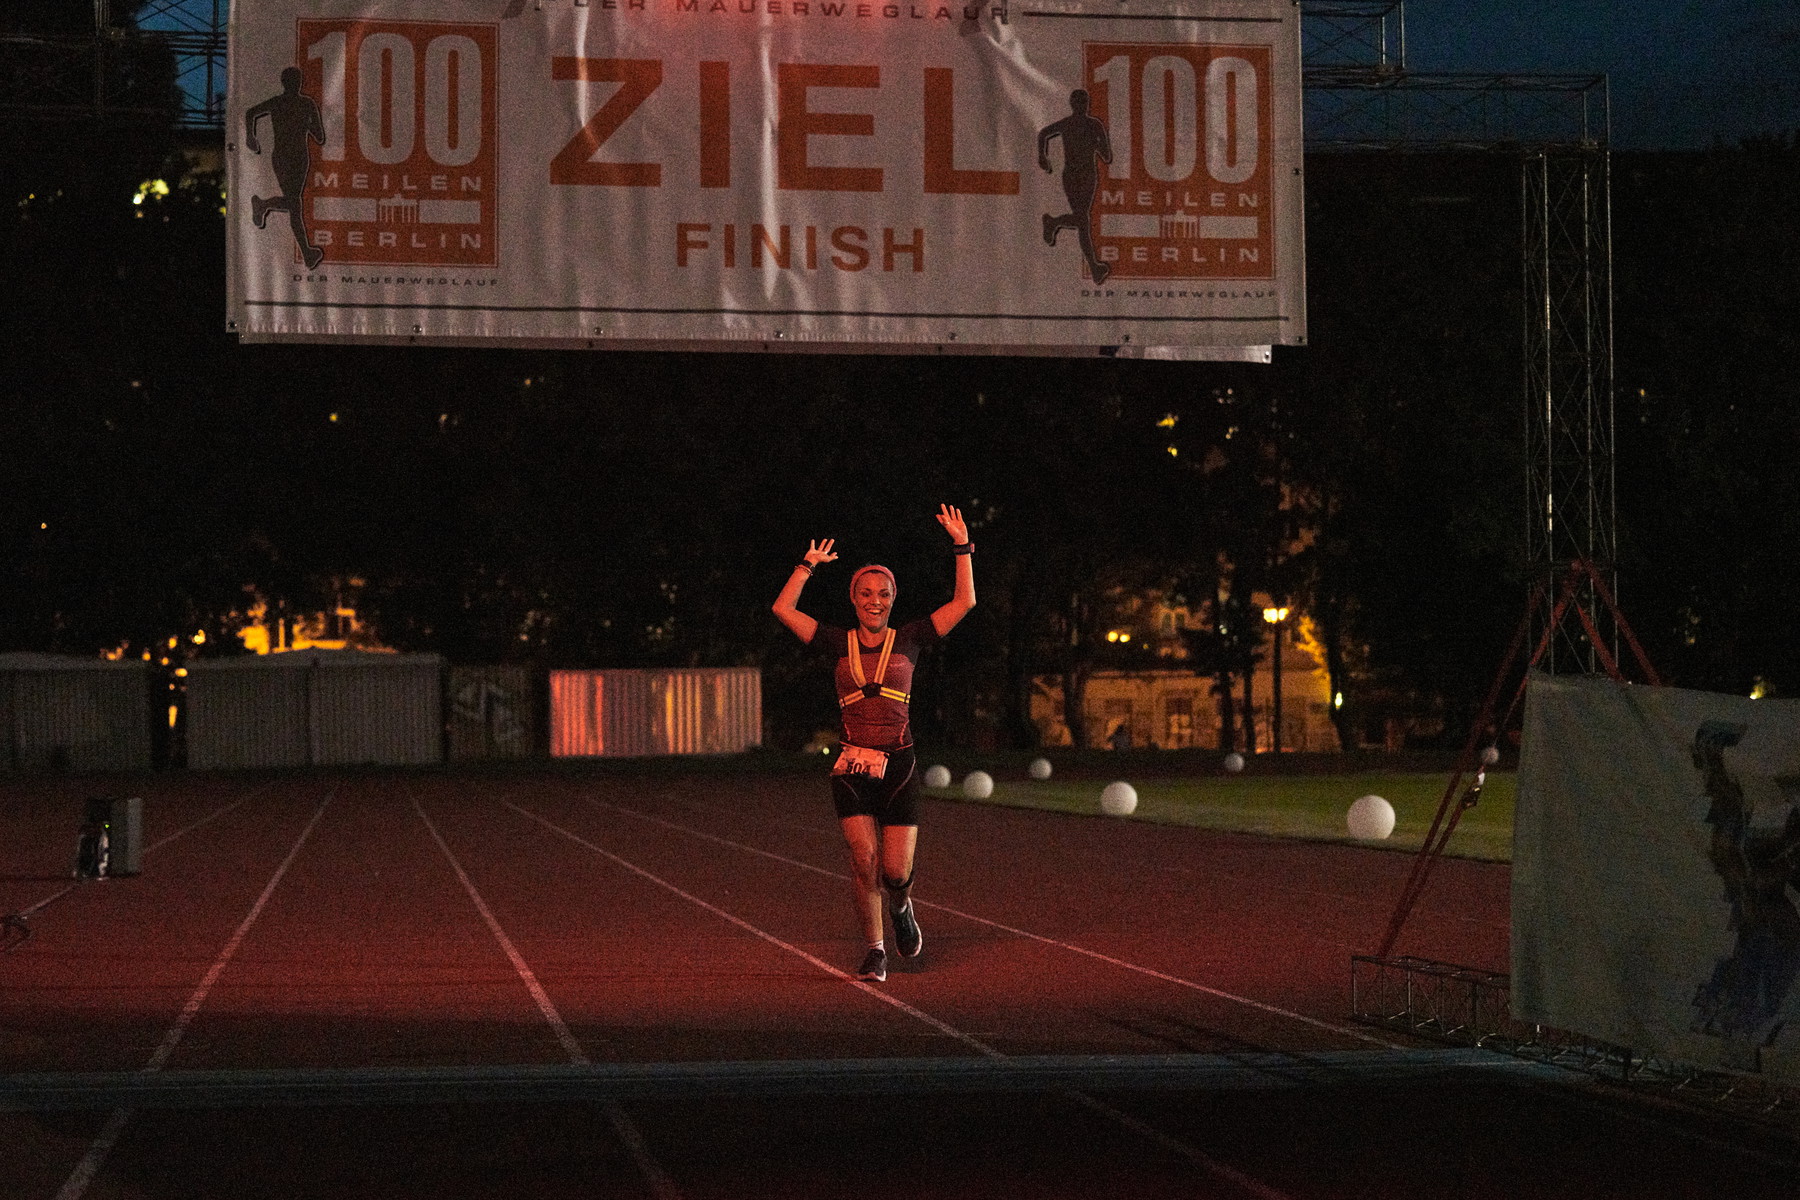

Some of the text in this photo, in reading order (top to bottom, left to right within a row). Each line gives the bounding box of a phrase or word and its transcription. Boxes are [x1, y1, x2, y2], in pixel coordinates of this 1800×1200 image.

[307, 31, 482, 167] 100
[550, 56, 1020, 196] ZIEL
[1094, 55, 1258, 184] 100
[313, 171, 482, 192] MEILEN
[1101, 190, 1259, 208] MEILEN
[313, 229, 482, 249] BERLIN
[676, 222, 924, 273] FINISH
[1100, 246, 1260, 263] BERLIN
[293, 274, 499, 287] DER MAUERWEGLAUF
[1080, 289, 1276, 299] DER MAUERWEGLAUF
